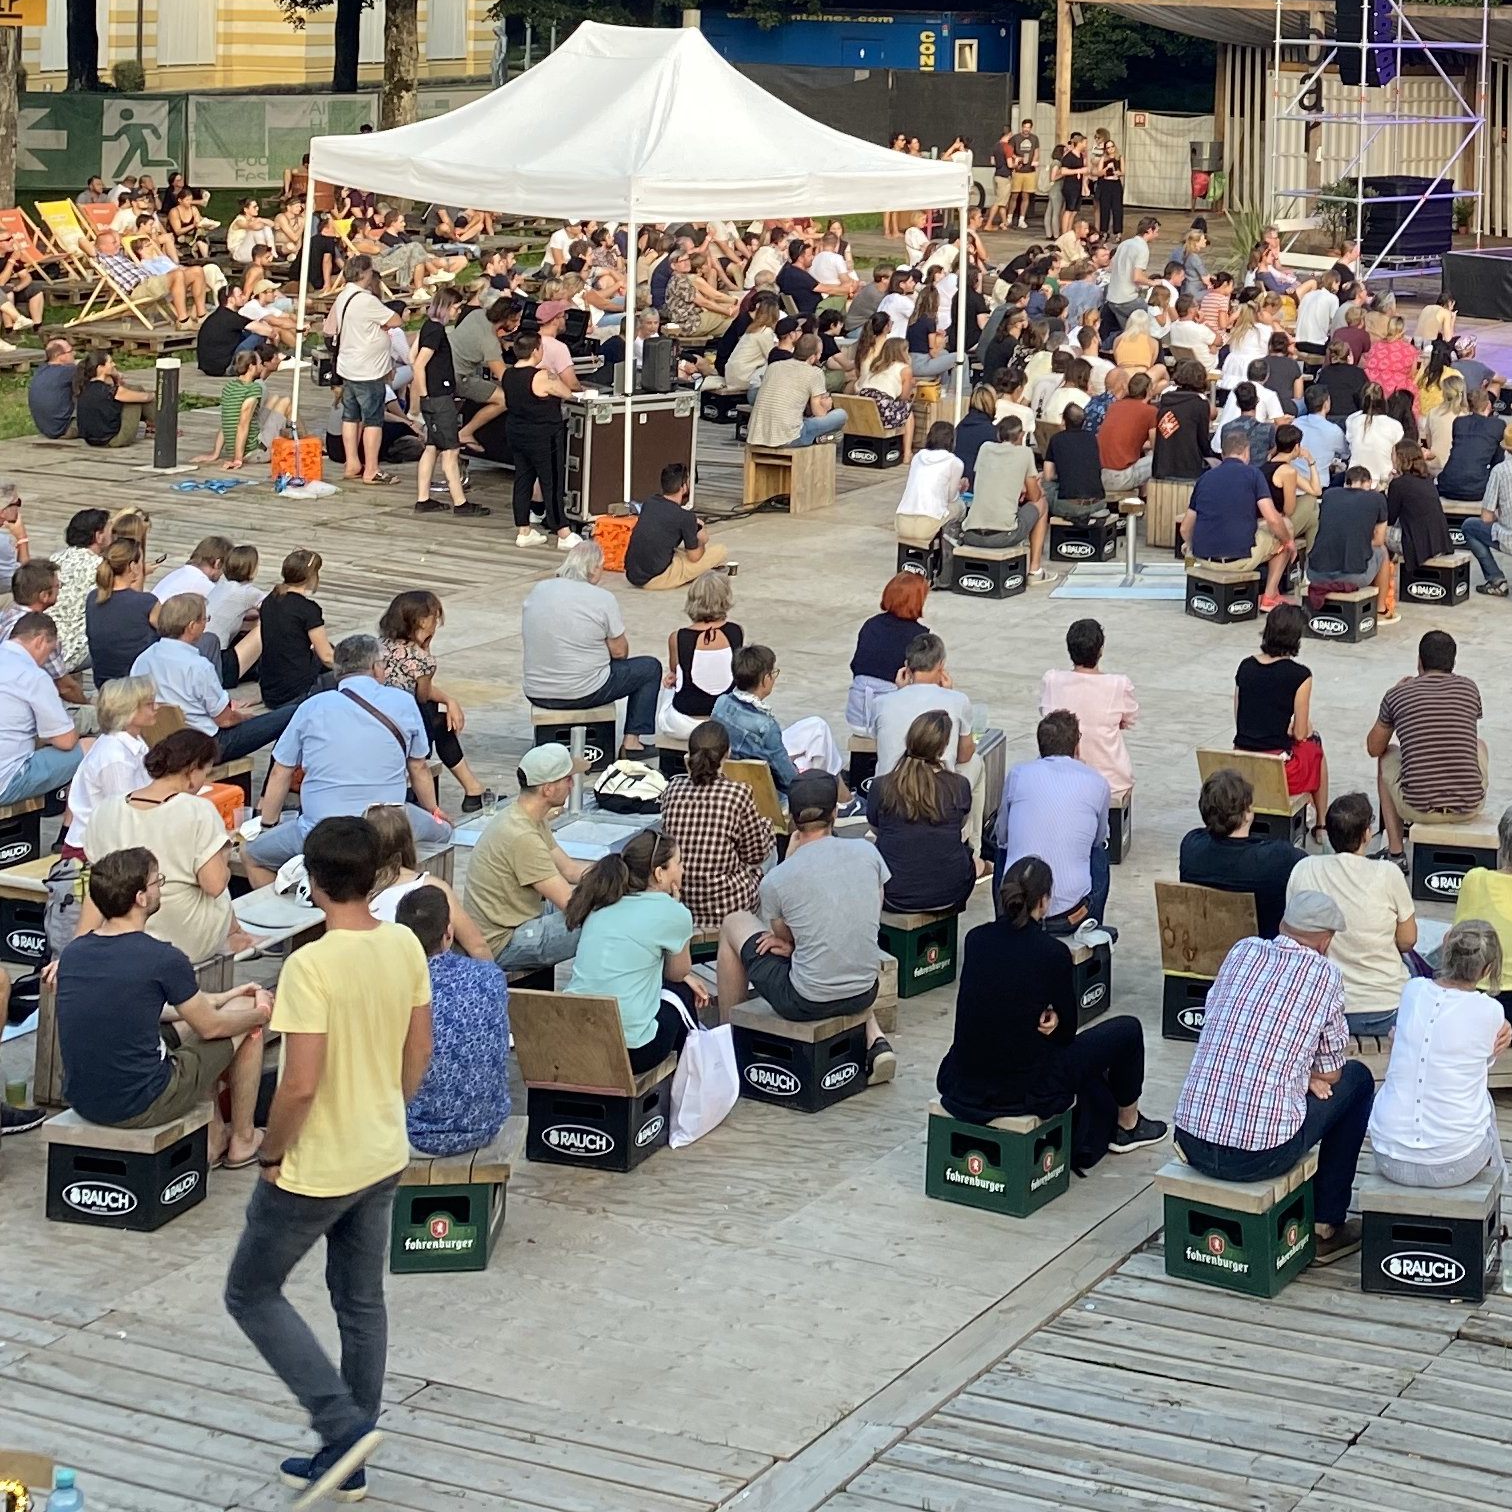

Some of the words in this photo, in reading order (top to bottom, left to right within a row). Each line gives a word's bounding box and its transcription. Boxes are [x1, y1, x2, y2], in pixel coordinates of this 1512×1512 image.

[1439, 876, 1460, 890] RAU
[22, 936, 46, 951] RAUC
[759, 1070, 795, 1091] RAUCH
[560, 1131, 606, 1151] RAUCH
[946, 1167, 1005, 1193] fohrenburger
[81, 1189, 129, 1209] RAUCH
[405, 1236, 474, 1253] fohrenburger
[1186, 1247, 1249, 1273] fohrenburger
[1402, 1259, 1456, 1279] RAUCH
